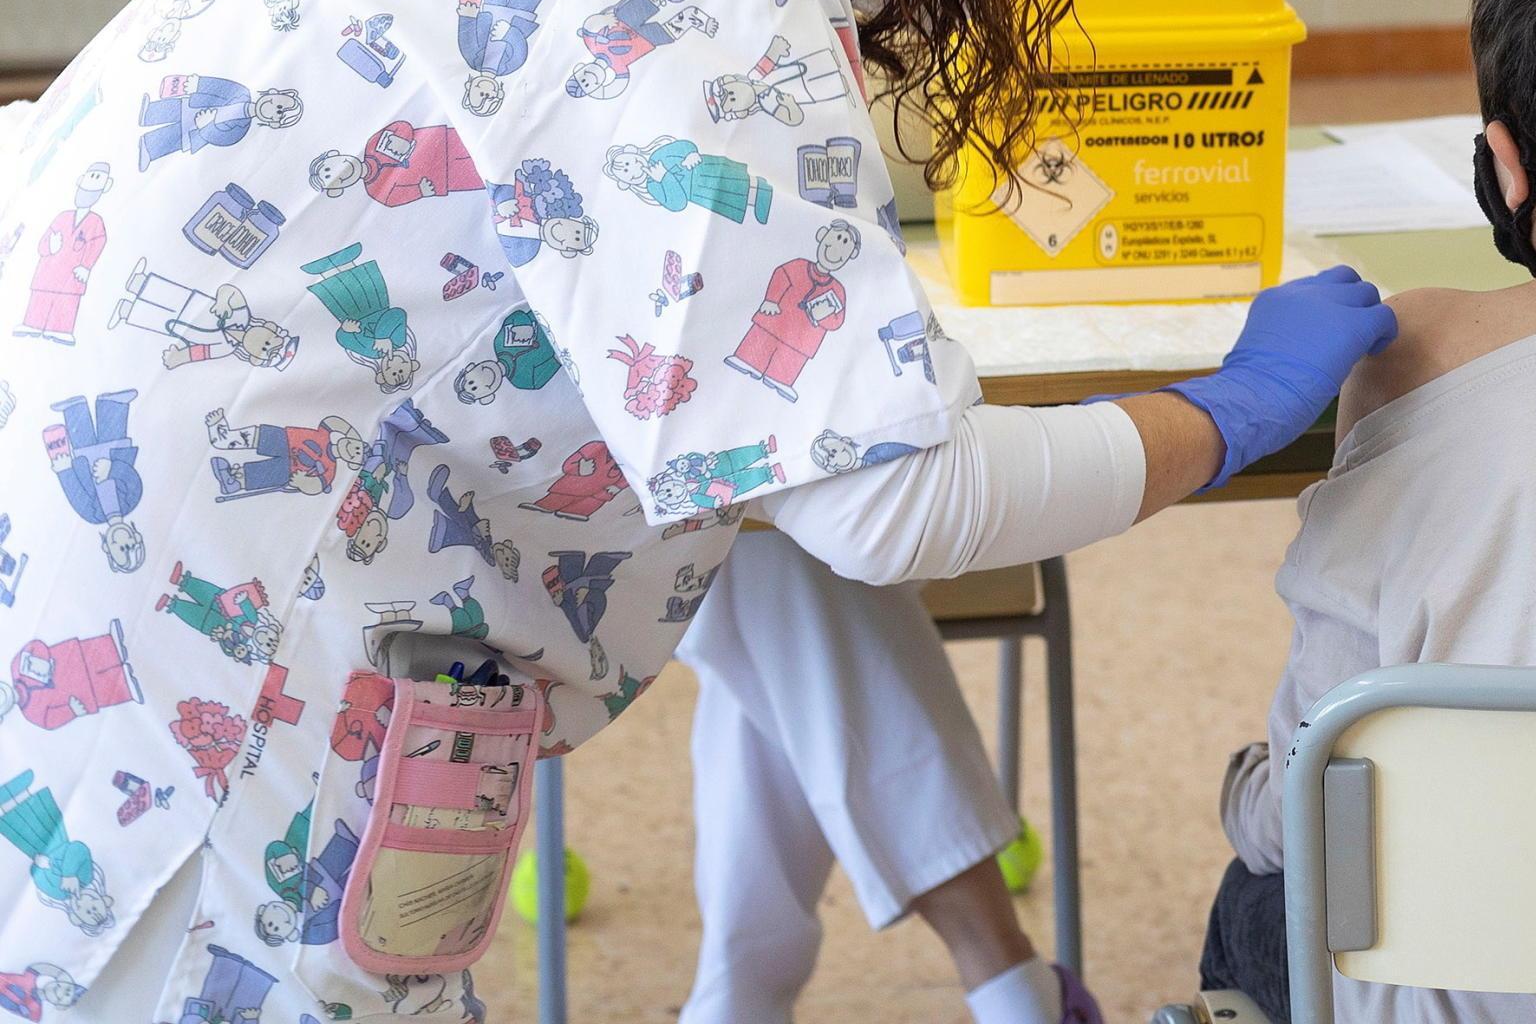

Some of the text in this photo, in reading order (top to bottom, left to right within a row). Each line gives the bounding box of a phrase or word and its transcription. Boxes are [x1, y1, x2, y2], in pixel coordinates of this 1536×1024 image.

[1132, 71, 1189, 85] LLENADO
[1077, 91, 1183, 113] PELIGRO
[1201, 130, 1264, 148] LITROS
[1134, 158, 1250, 185] ferrovial
[1134, 190, 1190, 204] servicios
[1048, 234, 1058, 248] 6
[240, 695, 276, 780] HOSPITAL
